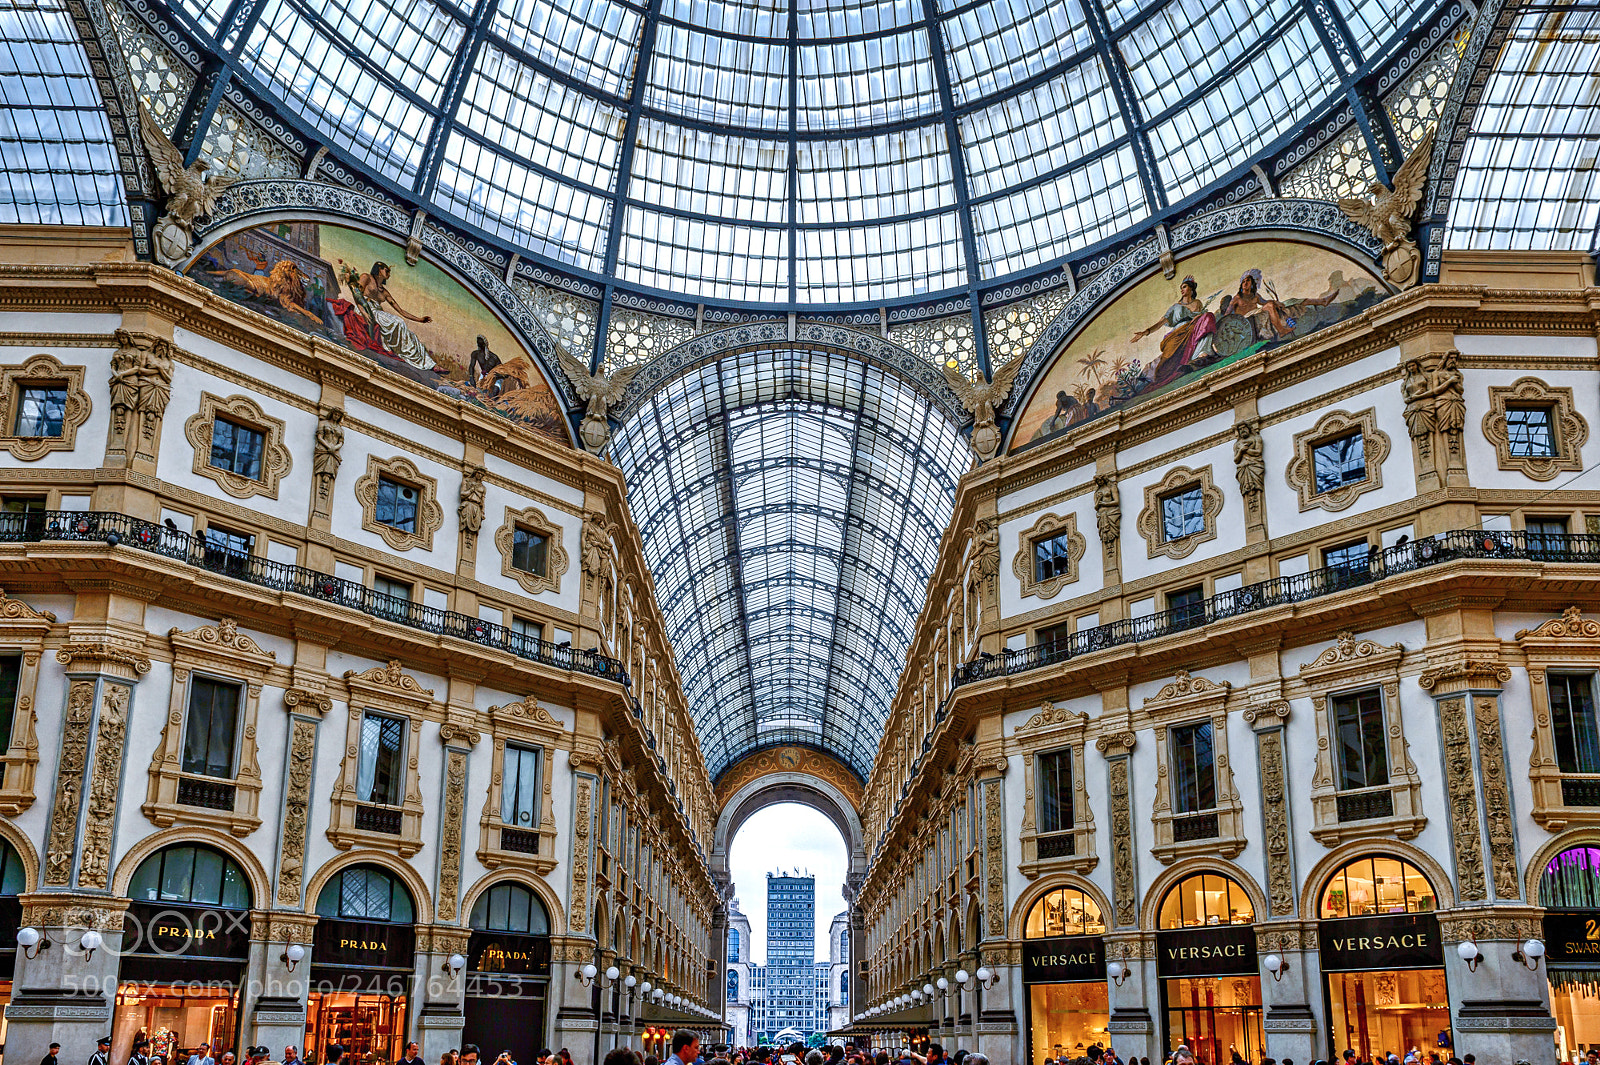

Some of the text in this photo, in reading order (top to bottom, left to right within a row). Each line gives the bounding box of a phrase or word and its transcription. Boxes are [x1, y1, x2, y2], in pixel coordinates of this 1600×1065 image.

[158, 926, 216, 940] PRADA
[340, 939, 388, 951] PRADA
[1333, 933, 1428, 951] VERSACE
[1565, 942, 1600, 954] SWAR
[488, 949, 527, 960] PRADA
[1168, 944, 1246, 960] VERSACE
[1032, 953, 1097, 967] VERSACE
